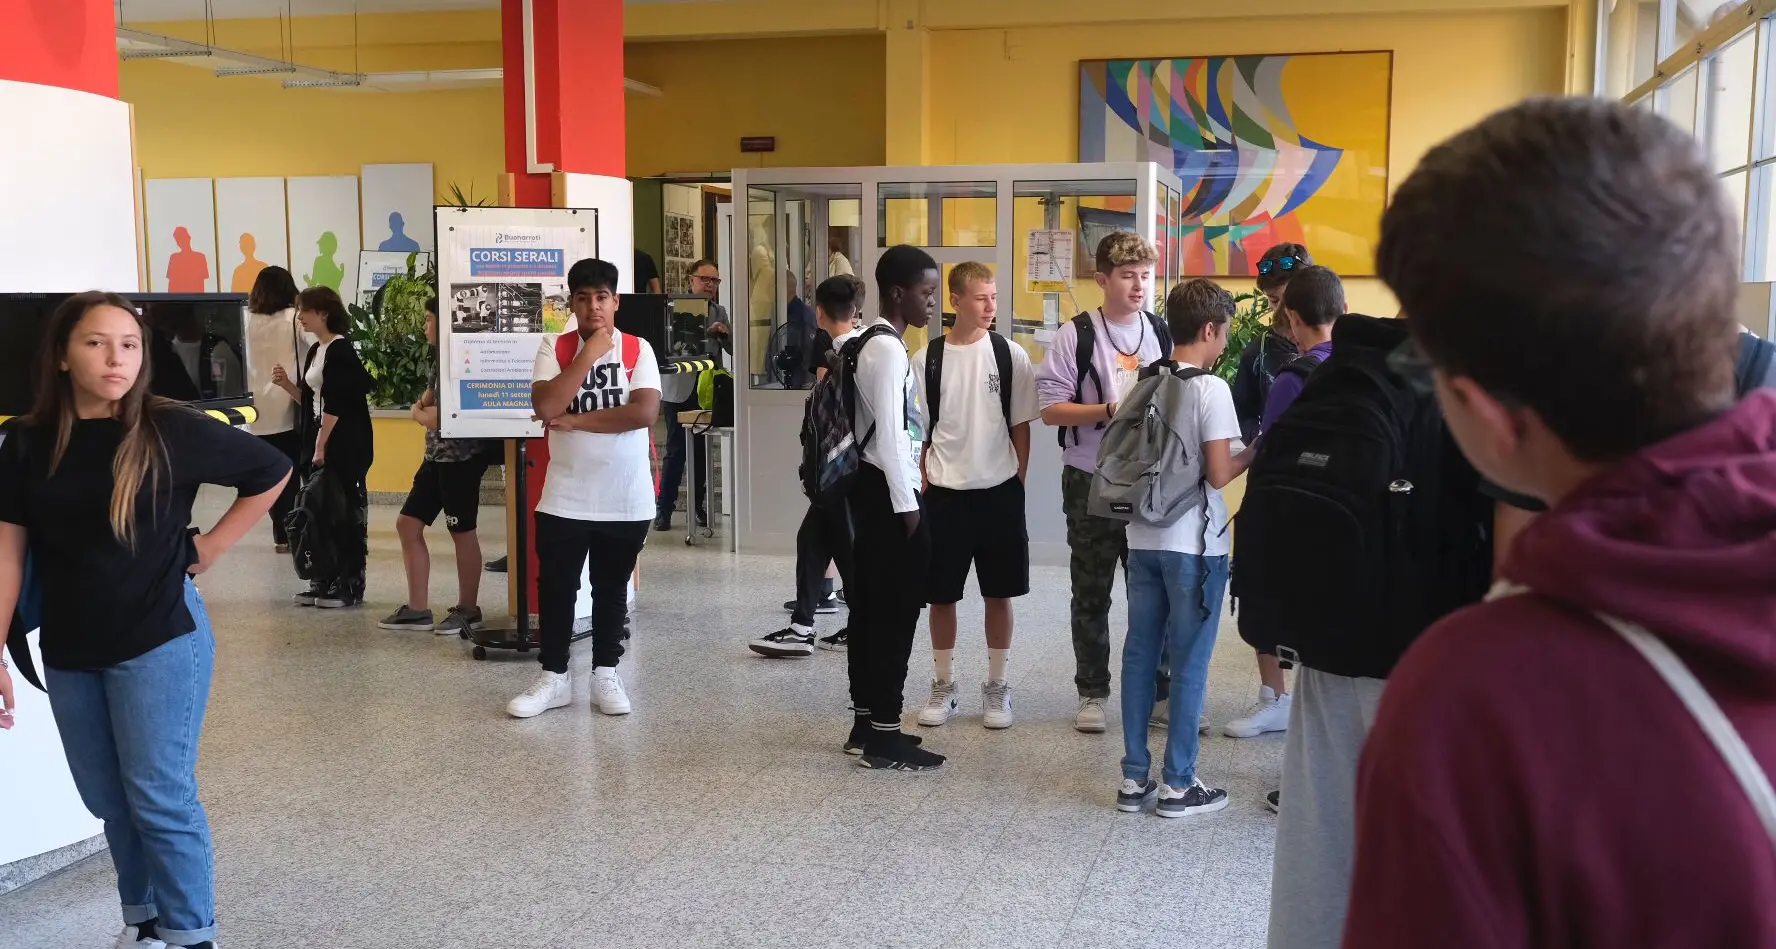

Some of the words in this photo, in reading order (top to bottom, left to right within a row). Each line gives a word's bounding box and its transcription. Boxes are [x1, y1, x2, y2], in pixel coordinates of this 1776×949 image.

[472, 250, 511, 262] CORSI
[514, 250, 559, 263] SERALI
[581, 362, 621, 391] UST
[601, 387, 624, 409] IT
